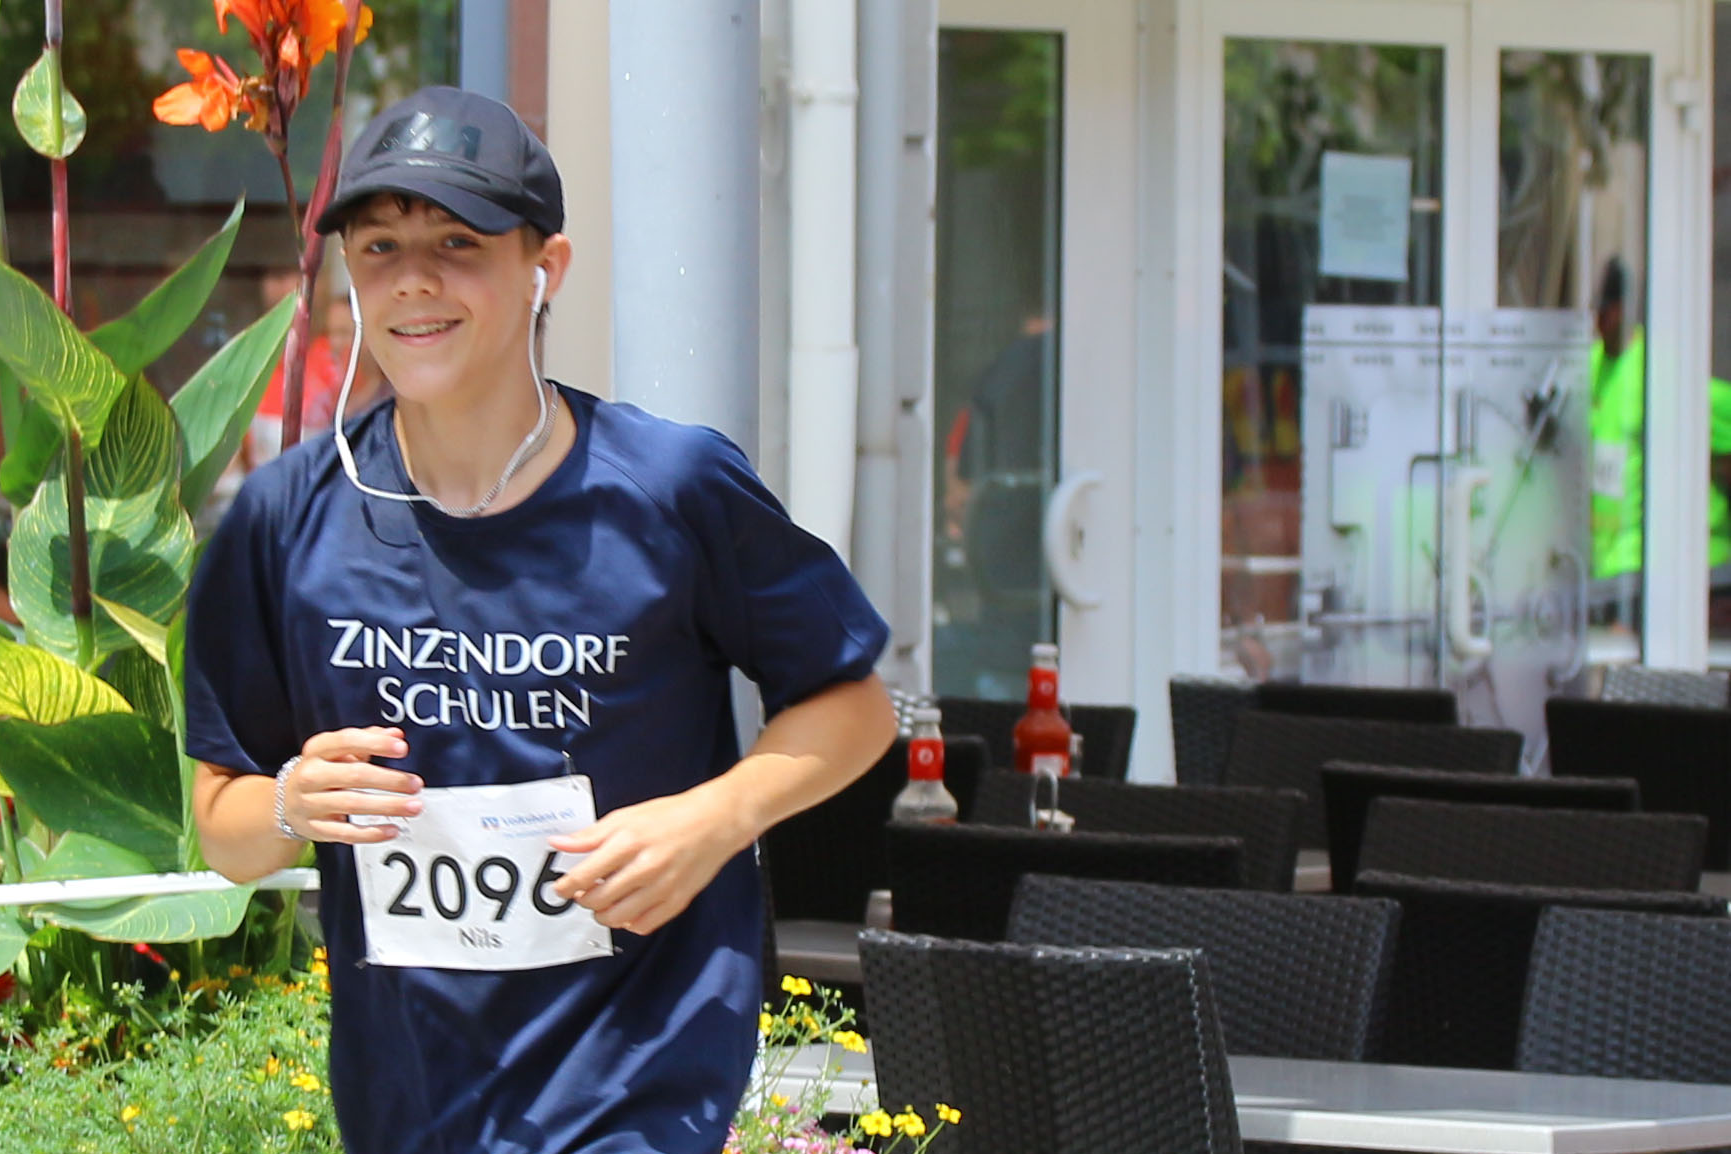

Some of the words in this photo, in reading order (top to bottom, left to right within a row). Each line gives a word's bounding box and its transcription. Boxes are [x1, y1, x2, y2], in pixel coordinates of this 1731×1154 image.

[327, 618, 630, 677] ZINZENDORF
[376, 676, 591, 731] SCHULEN
[383, 851, 574, 921] 2096
[459, 927, 502, 949] Nils
